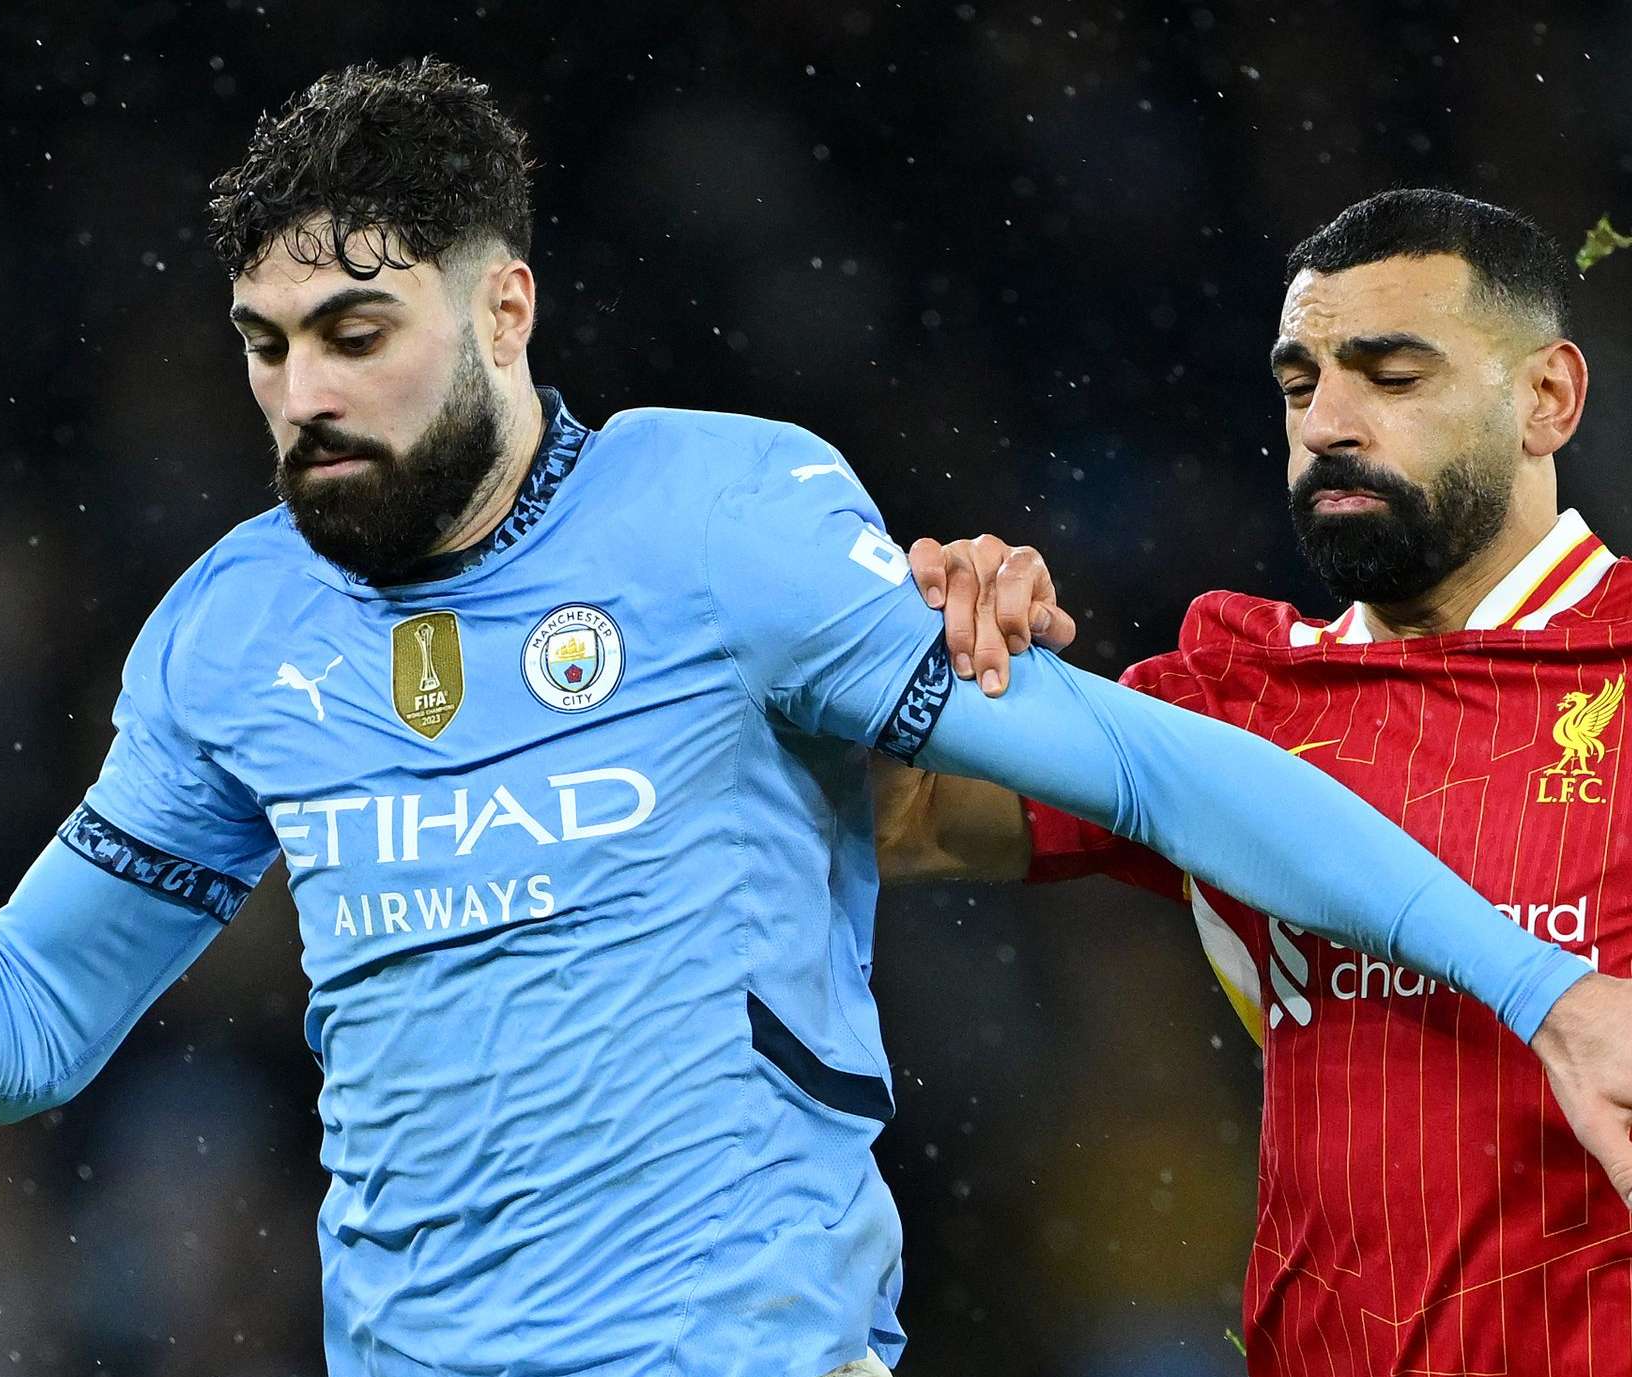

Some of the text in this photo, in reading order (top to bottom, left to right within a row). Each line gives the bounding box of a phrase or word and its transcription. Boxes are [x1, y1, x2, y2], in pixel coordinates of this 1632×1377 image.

[532, 611, 612, 649] MANCHESTER
[414, 691, 447, 711] FIFA
[562, 693, 593, 706] CITY
[421, 714, 441, 726] 2023
[266, 768, 656, 868] ETIHAD
[334, 874, 556, 938] AIRWAYS
